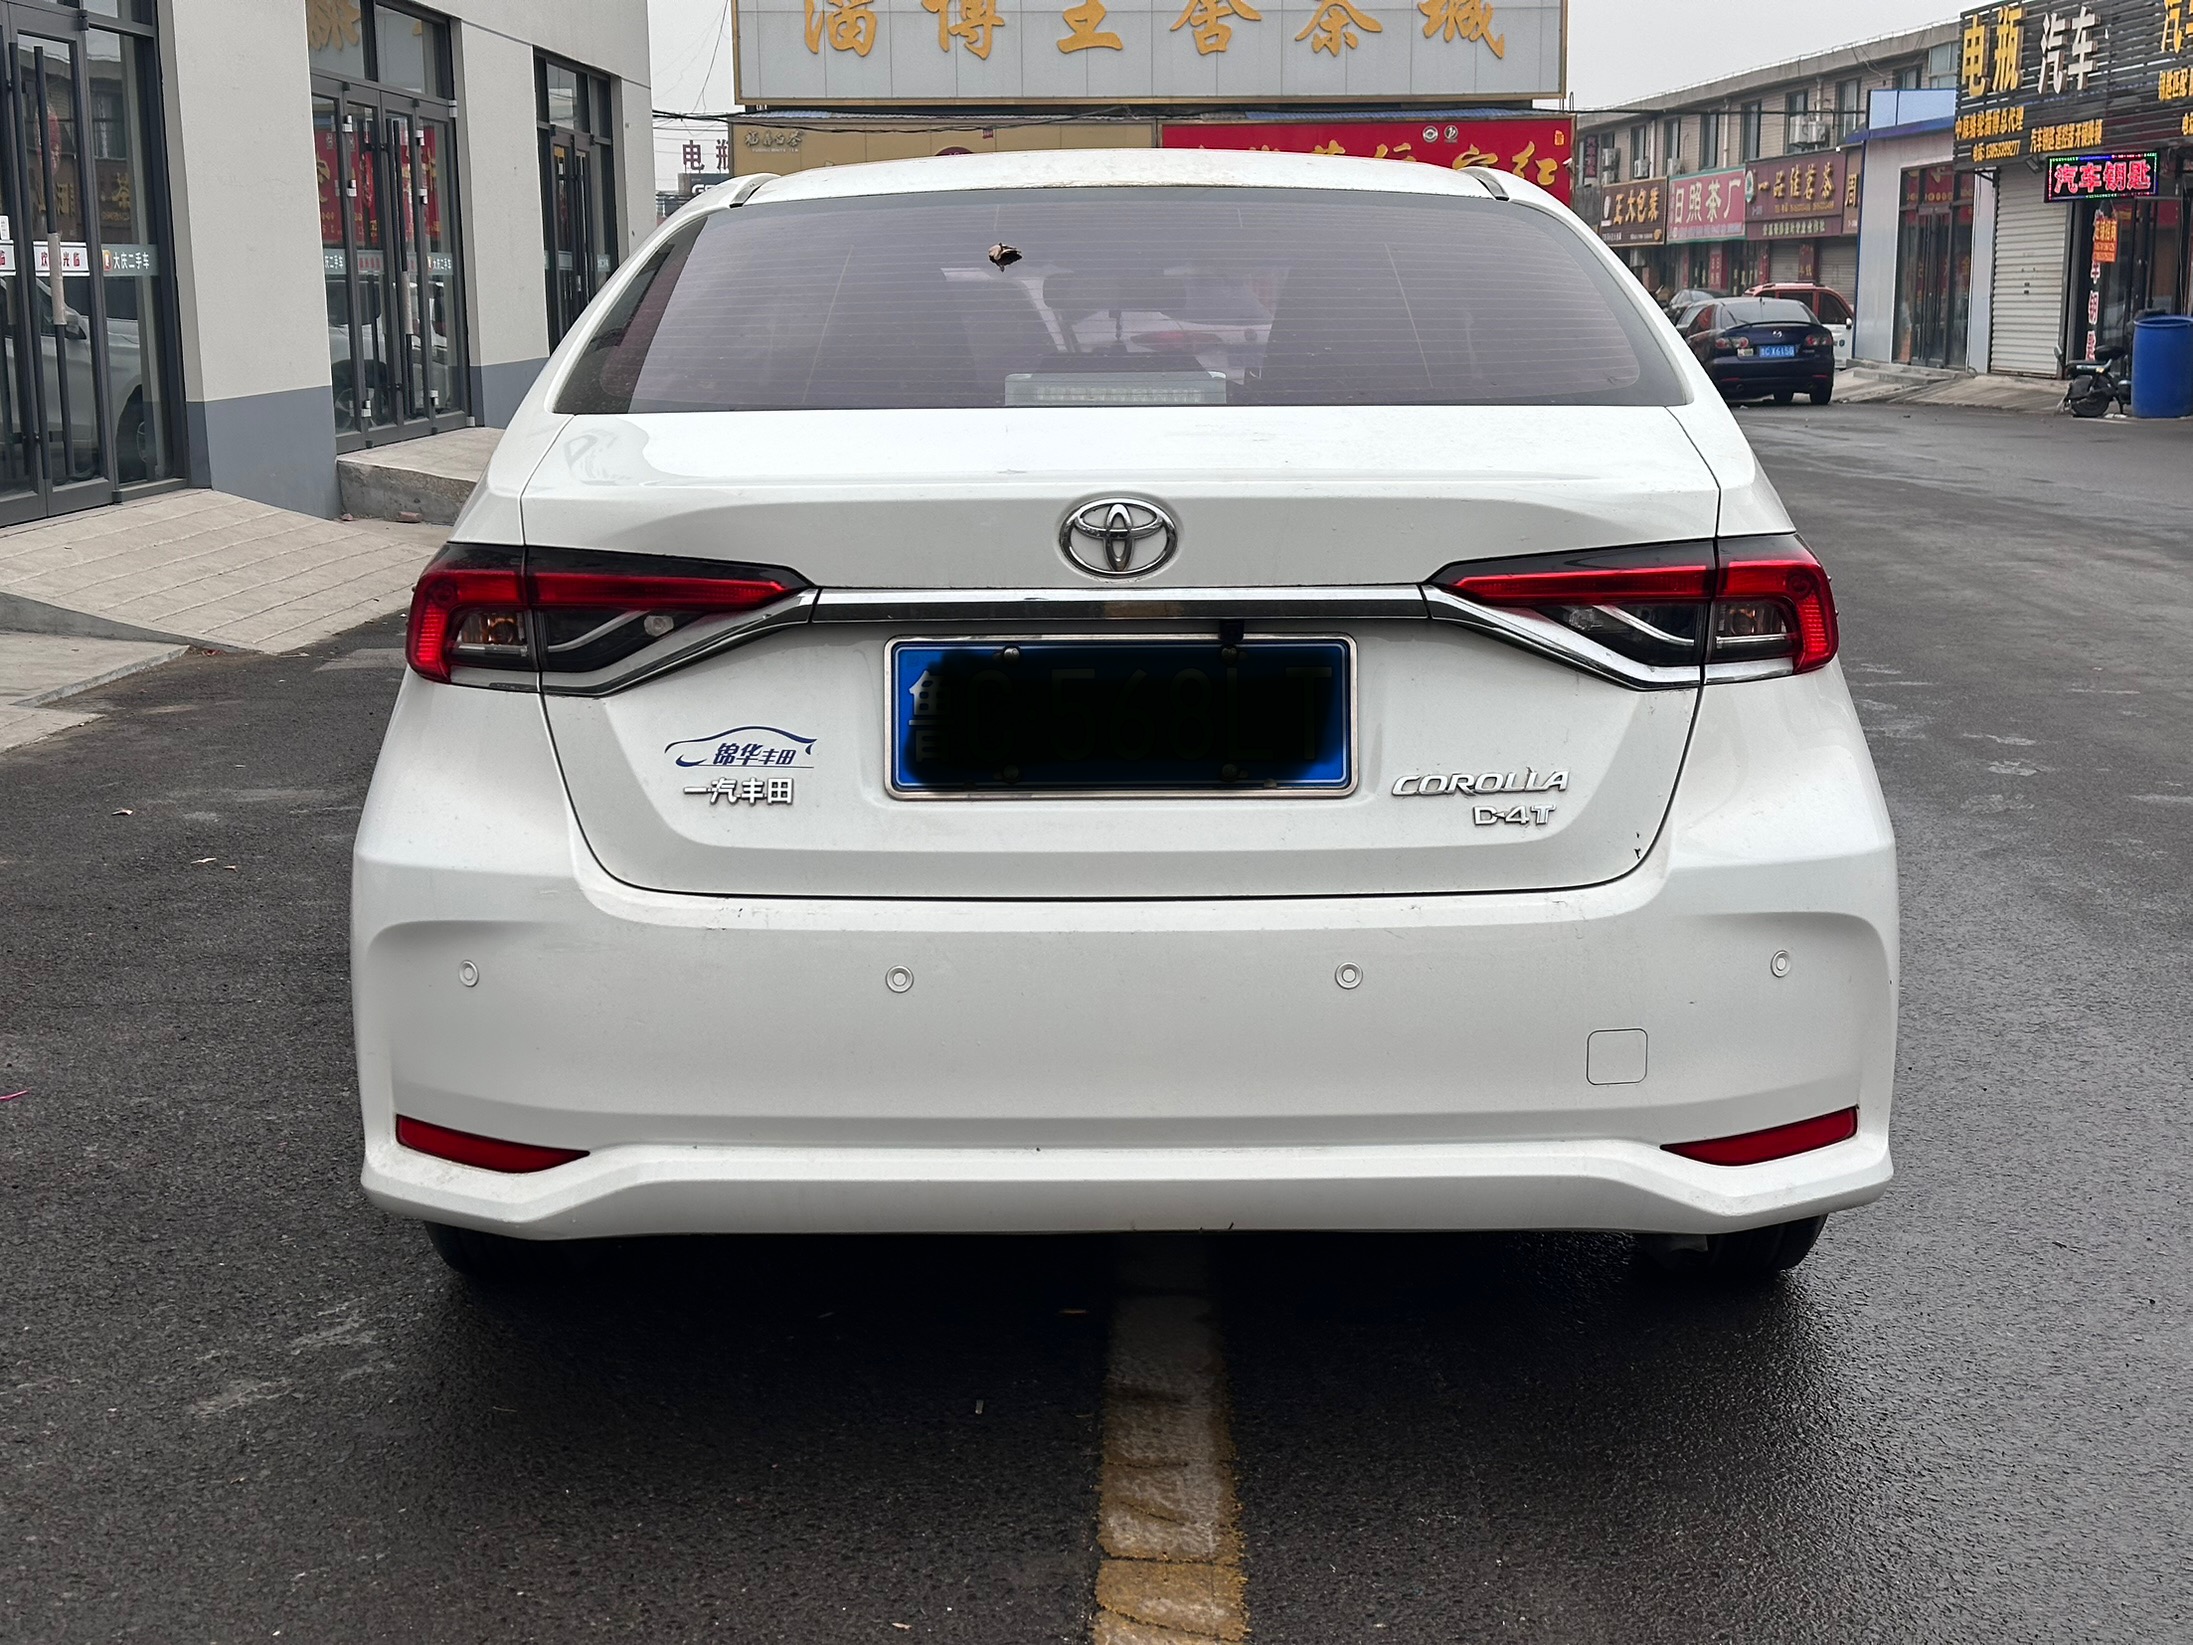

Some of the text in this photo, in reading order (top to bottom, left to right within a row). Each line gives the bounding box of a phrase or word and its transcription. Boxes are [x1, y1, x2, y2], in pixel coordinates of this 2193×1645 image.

[1962, 6, 2025, 96] 电瓶
[2037, 5, 2099, 95] 汽车
[2054, 159, 2151, 194] 汽车钥匙
[1675, 179, 1741, 224] 日照茶厂
[41, 251, 80, 267] 欢光临
[713, 742, 796, 766] 锦华丰田
[683, 777, 794, 805] 一汽丰田
[1392, 769, 1571, 797] COROLLA
[1473, 804, 1556, 826] D-4T
